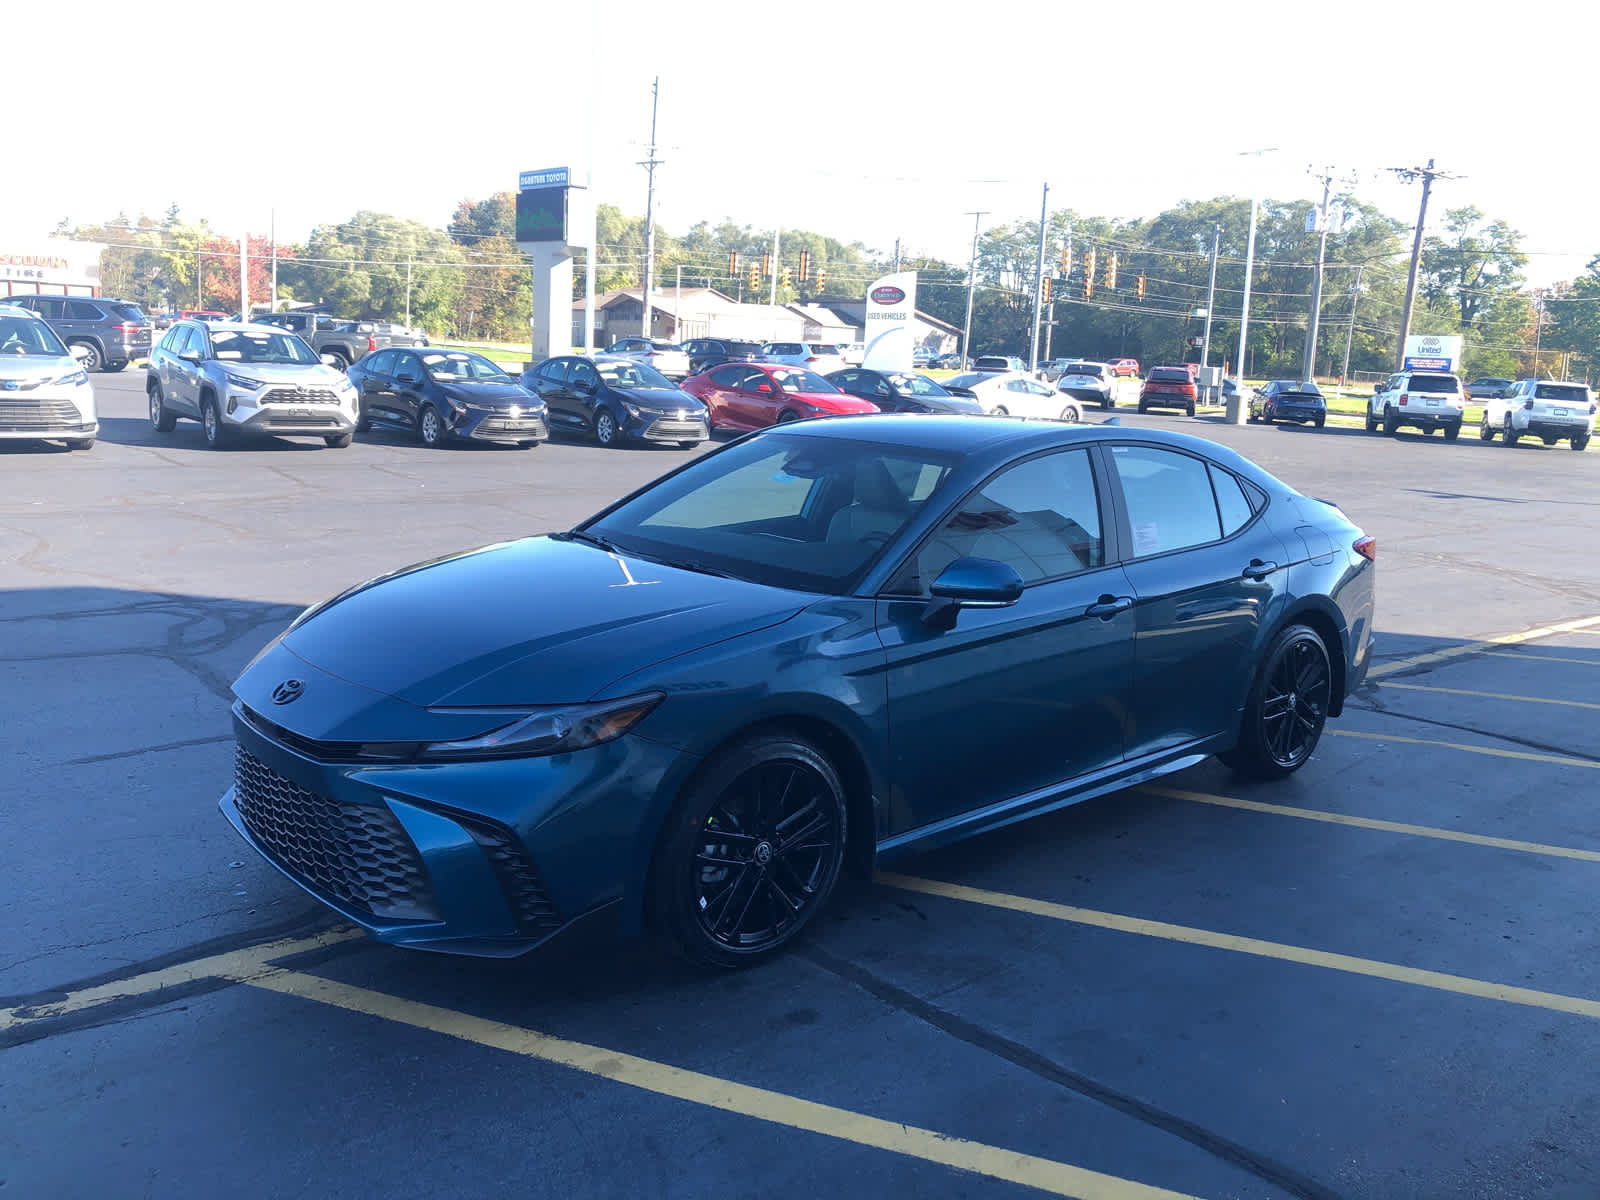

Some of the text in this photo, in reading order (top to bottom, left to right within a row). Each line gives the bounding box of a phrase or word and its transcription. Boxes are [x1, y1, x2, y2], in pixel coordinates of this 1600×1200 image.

[546, 172, 567, 183] TOYOTA
[6, 268, 44, 278] TIRE
[867, 312, 907, 320] USED VEHICLES
[1417, 345, 1441, 353] United
